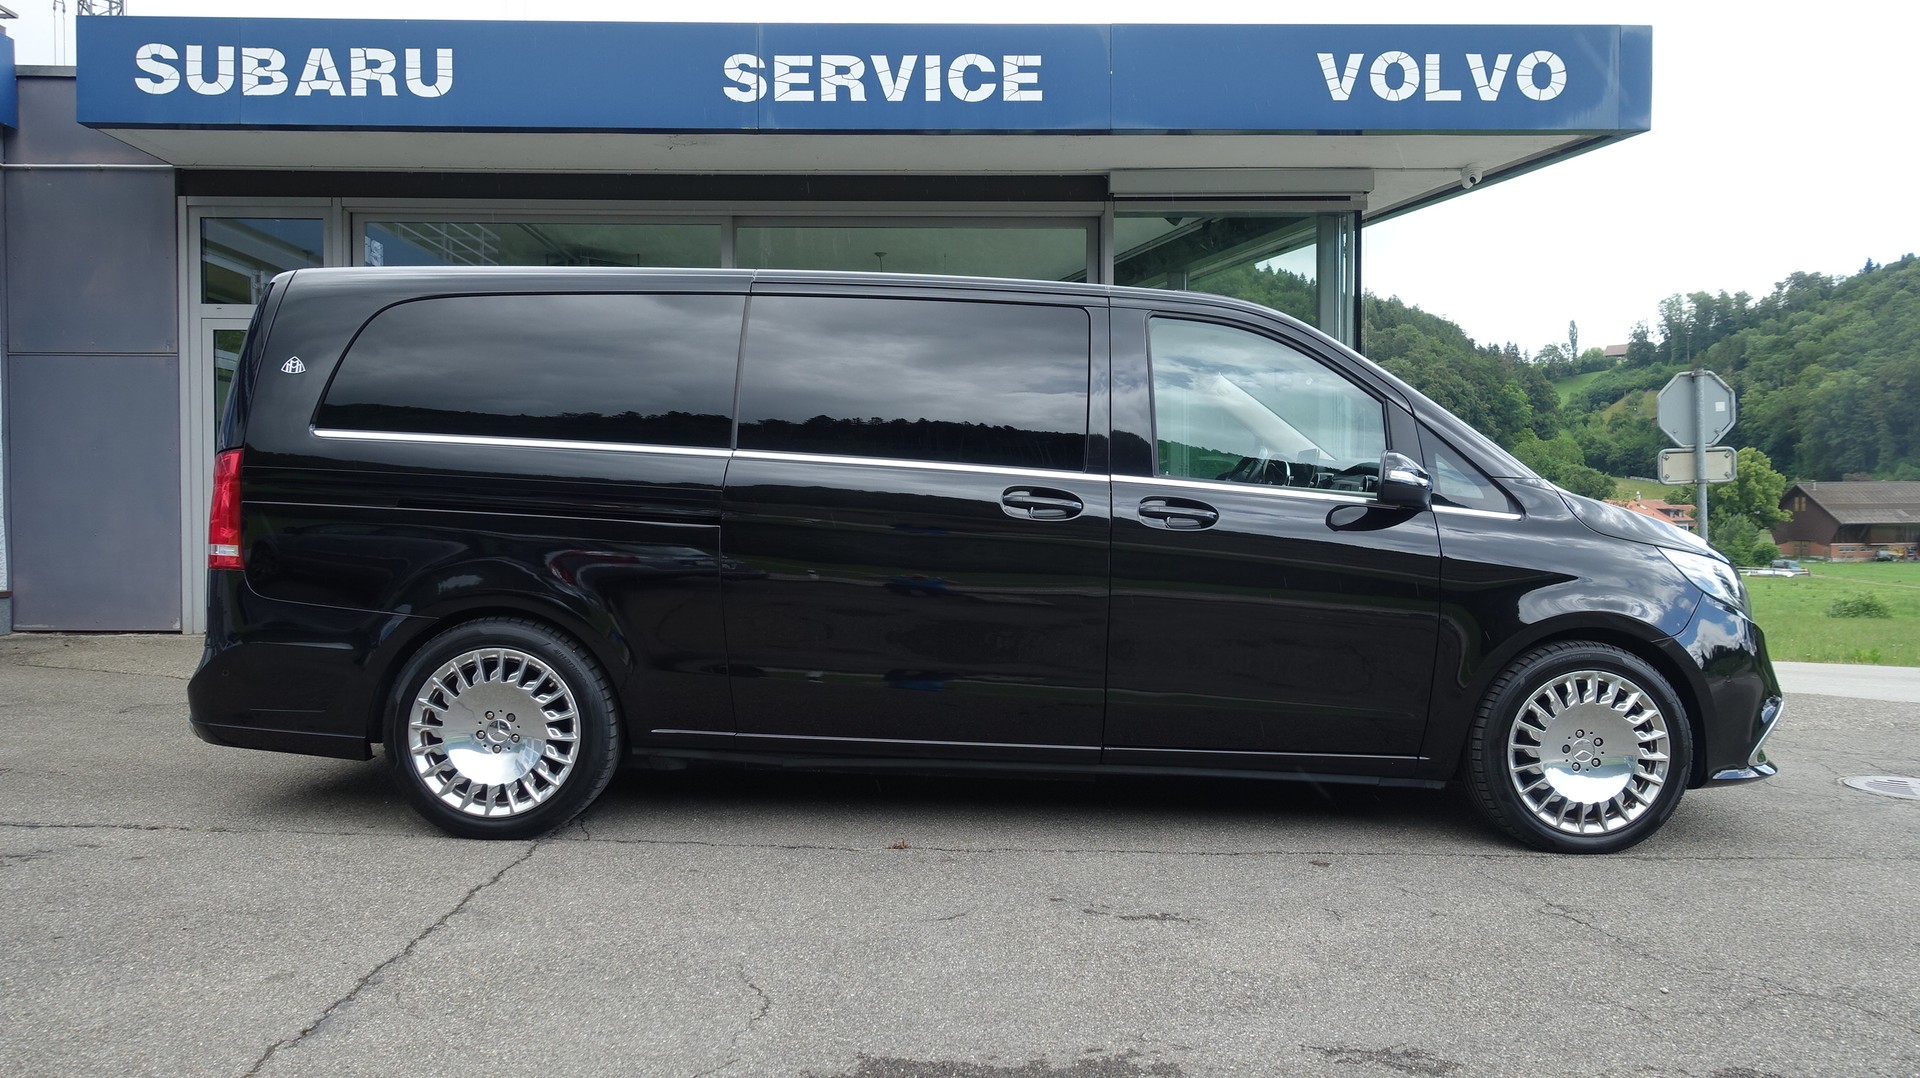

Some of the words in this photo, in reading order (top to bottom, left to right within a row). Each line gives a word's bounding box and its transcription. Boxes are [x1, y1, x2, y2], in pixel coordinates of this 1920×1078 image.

[134, 43, 454, 98] SUBARU
[722, 53, 1043, 103] SERVICE
[1316, 50, 1567, 102] VOLVO
